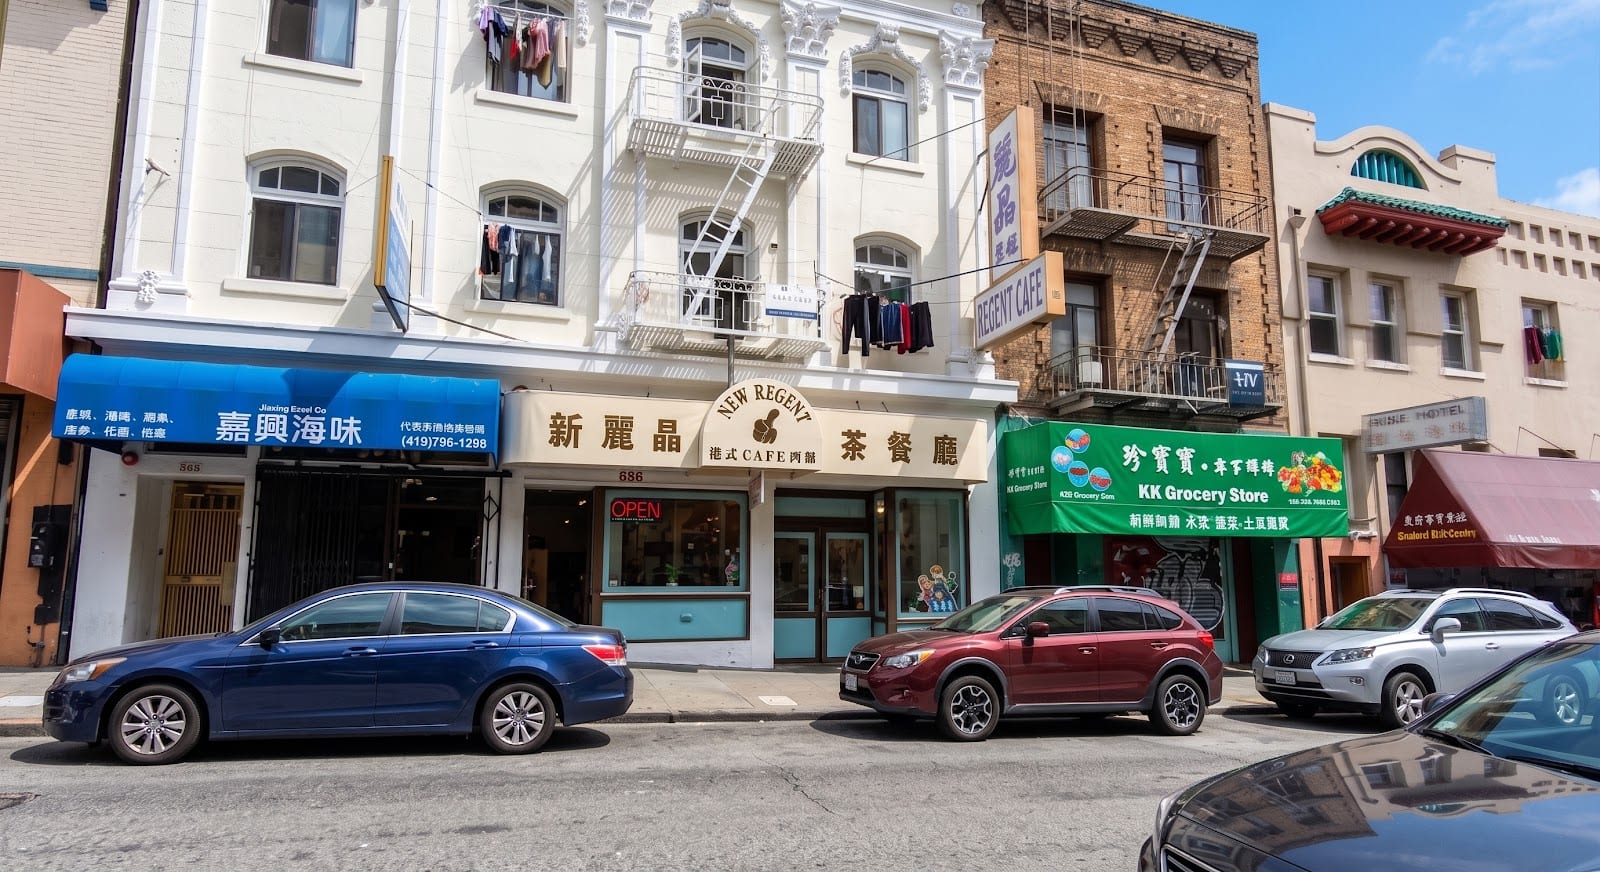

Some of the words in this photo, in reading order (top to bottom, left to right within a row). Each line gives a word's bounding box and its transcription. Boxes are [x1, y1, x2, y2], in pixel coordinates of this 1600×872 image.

[977, 284, 1013, 338] REGENT
[1016, 267, 1042, 317] CAFE
[259, 404, 289, 414] Jiaxing
[314, 406, 327, 414] Co
[717, 387, 748, 419] NEW
[754, 384, 812, 423] REGENT
[215, 411, 362, 445] 嘉興海味
[401, 435, 487, 450] (419)796-1298
[548, 412, 681, 453] 新麗晶
[841, 429, 958, 465] 茶餐廳
[742, 449, 785, 463] CAFE
[619, 471, 643, 482] 686
[1074, 491, 1100, 500] Grocery
[1138, 484, 1162, 500] KK
[1165, 485, 1226, 505] Grocery
[1229, 487, 1269, 503] Store
[611, 500, 662, 519] OPEN
